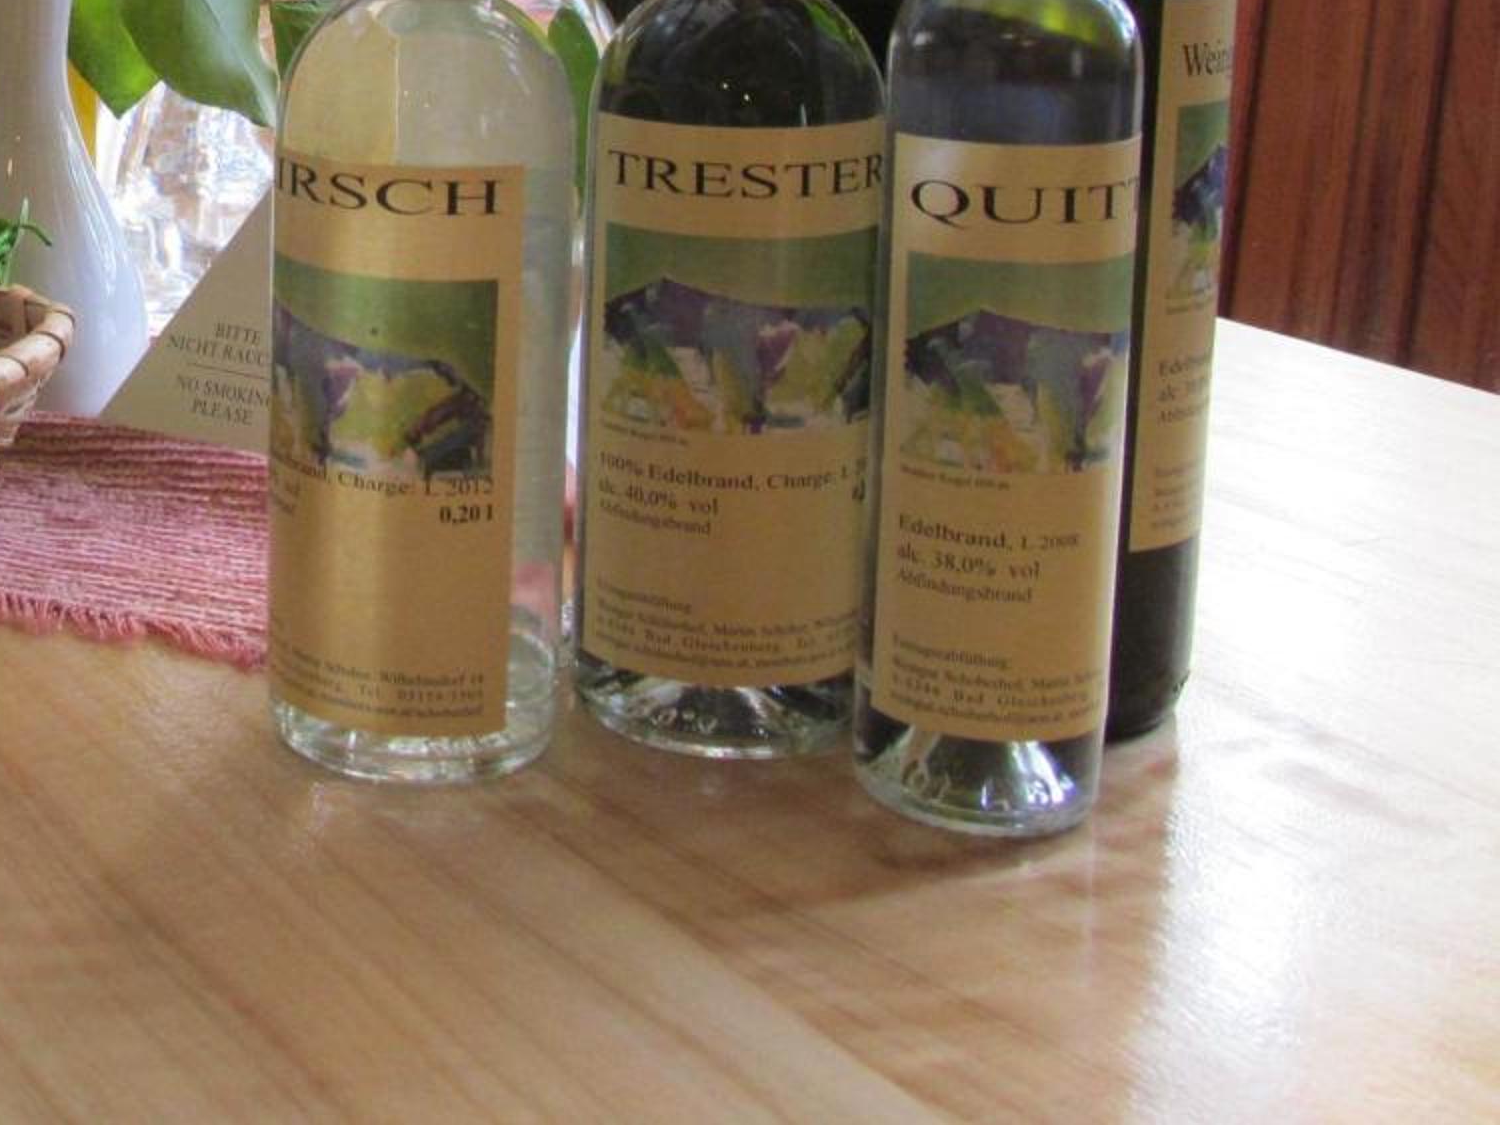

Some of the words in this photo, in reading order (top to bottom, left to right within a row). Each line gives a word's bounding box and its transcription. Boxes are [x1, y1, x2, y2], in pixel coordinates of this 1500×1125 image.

[607, 149, 883, 199] TRESTER
[911, 176, 1140, 231] QUIT
[214, 321, 260, 346] BITTE
[168, 335, 219, 359] NICHT
[191, 397, 254, 425] PLEASE
[439, 503, 481, 524] 0,20
[689, 496, 719, 516] vol
[1008, 560, 1041, 581] vol
